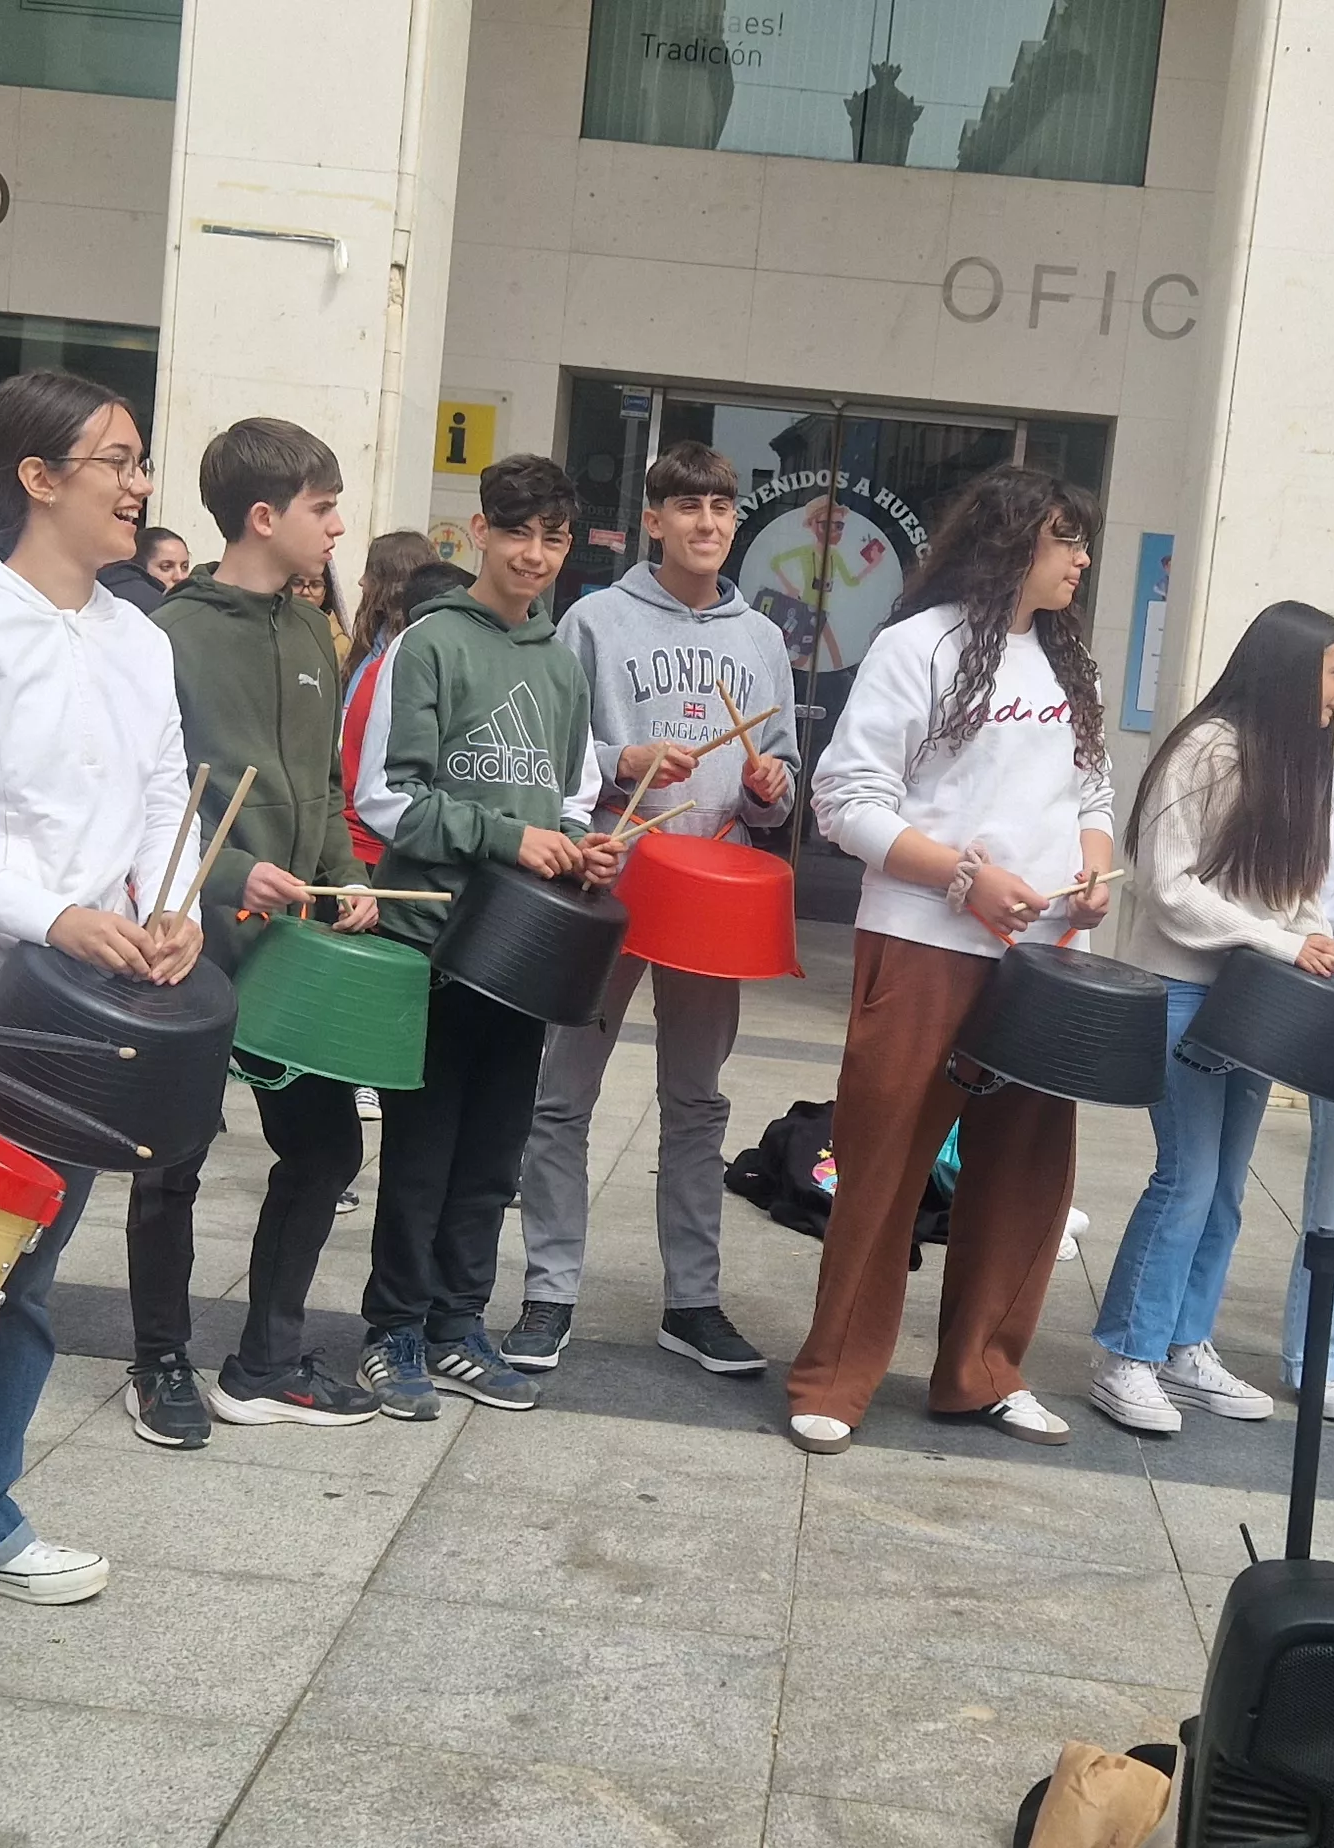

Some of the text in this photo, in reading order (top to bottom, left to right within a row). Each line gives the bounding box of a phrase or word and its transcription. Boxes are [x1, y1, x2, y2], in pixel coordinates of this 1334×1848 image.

[640, 32, 763, 68] Tradición
[942, 256, 1200, 341] OFIC
[853, 477, 871, 498] A
[873, 487, 933, 569] HUESC
[624, 646, 756, 717] LONDON
[651, 719, 733, 746] ENGLAND
[968, 696, 1074, 726] adid
[447, 745, 560, 793] adida
